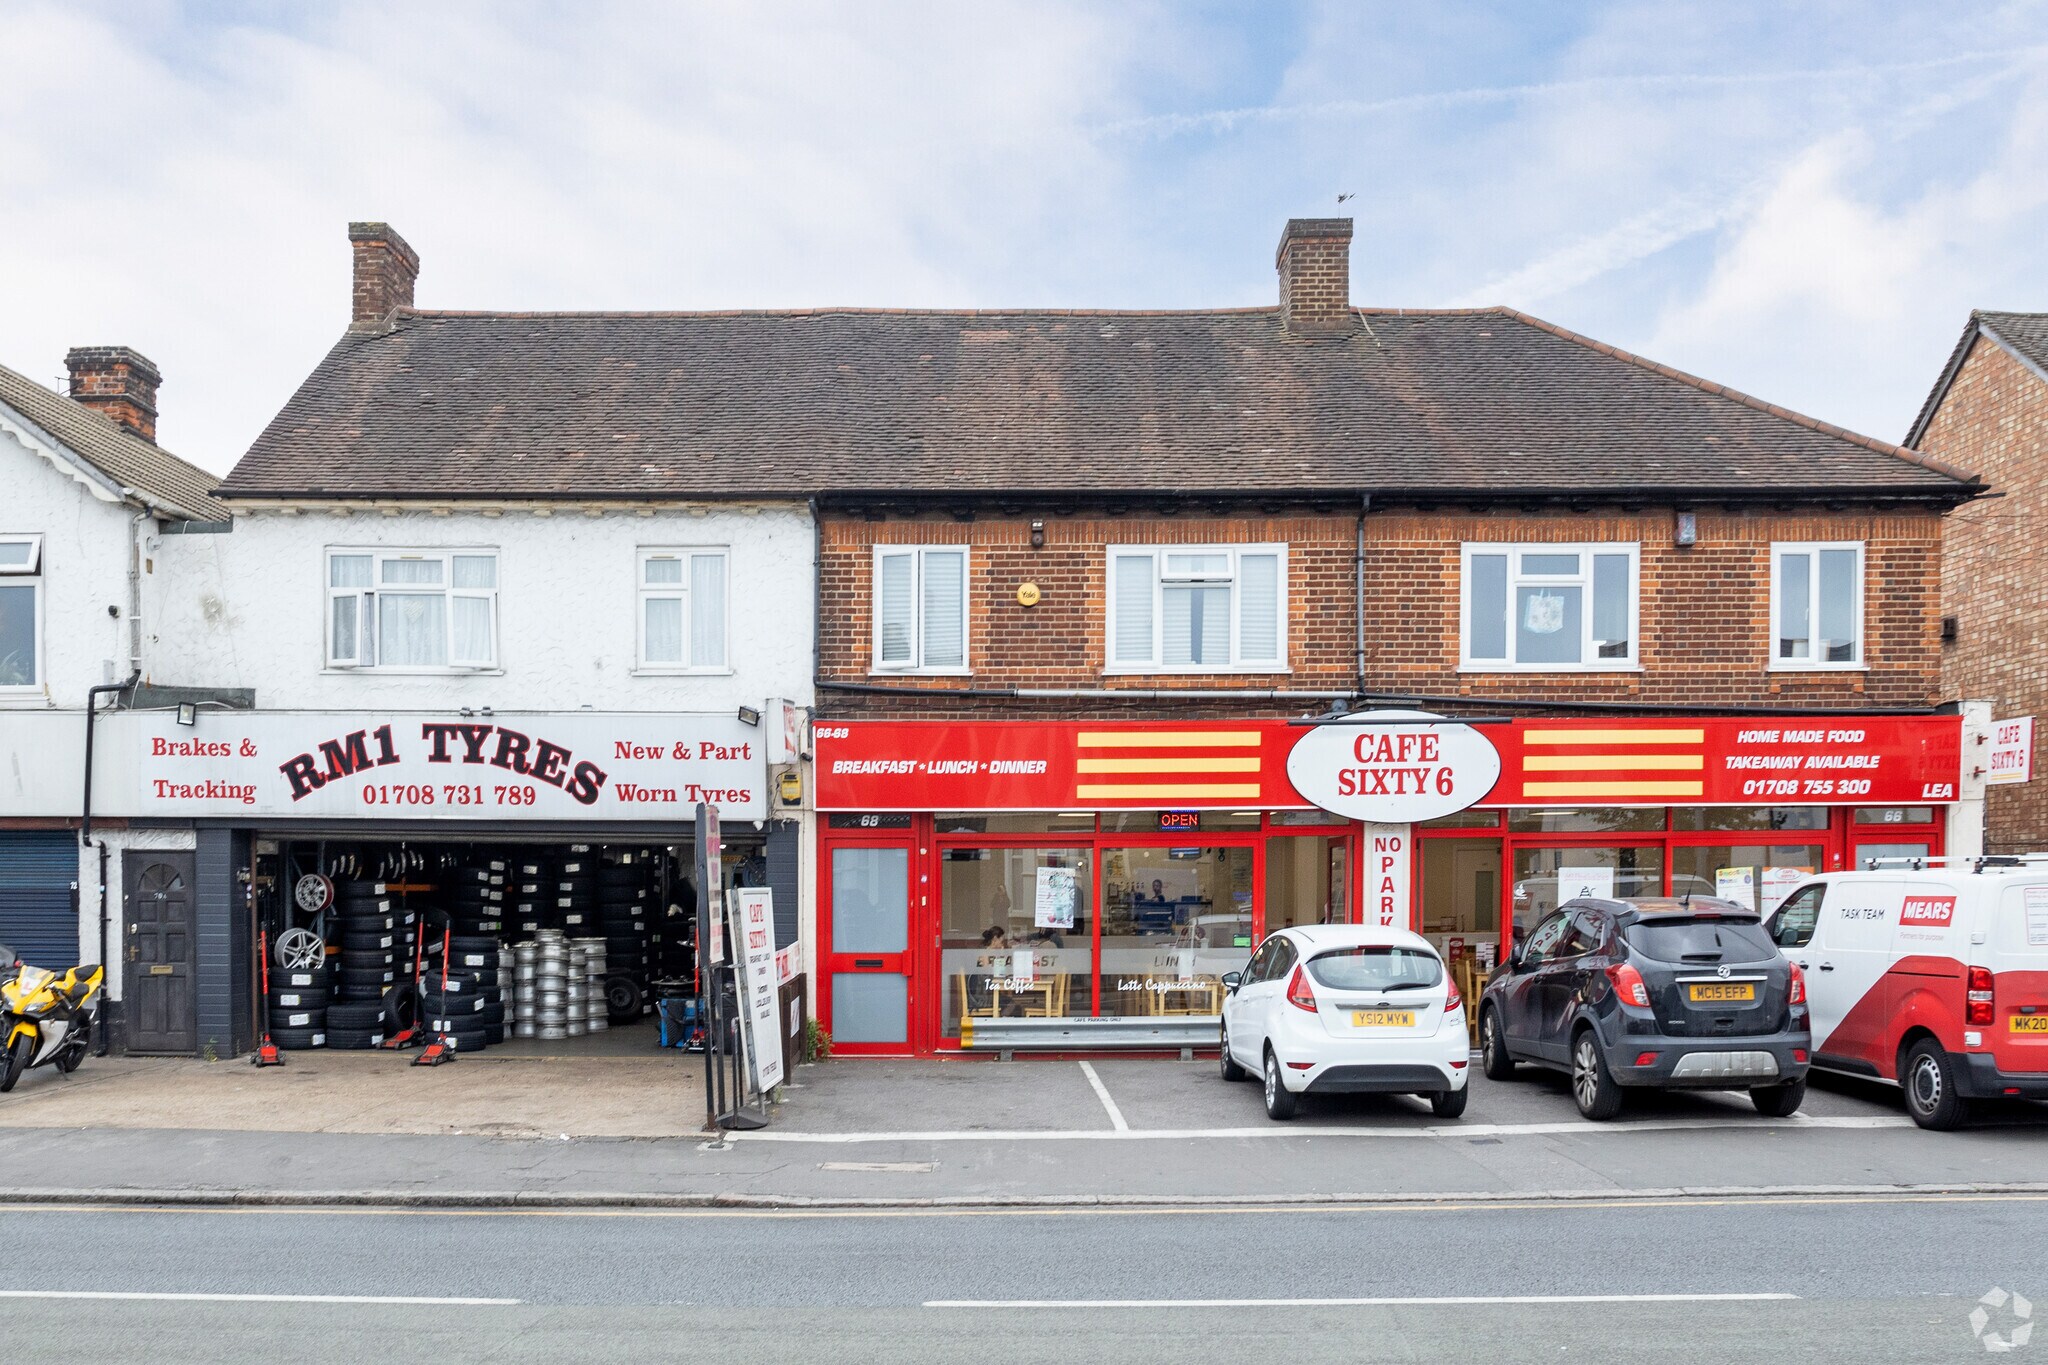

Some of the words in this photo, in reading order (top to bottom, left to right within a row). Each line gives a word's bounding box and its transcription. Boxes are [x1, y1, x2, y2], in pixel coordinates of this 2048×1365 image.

[816, 728, 849, 738] 66-68
[1737, 730, 1779, 743] HOME
[1782, 730, 1825, 743] MADE
[1827, 730, 1865, 743] FOOD
[152, 738, 231, 757] Brakes
[239, 738, 258, 758] &
[614, 741, 664, 760] New
[672, 741, 691, 760] &
[699, 742, 751, 760] Part
[279, 723, 400, 802] RM1
[422, 722, 608, 806] TYRES
[832, 760, 917, 774] BREAKFAST
[927, 760, 977, 774] LUNCH
[989, 760, 1047, 774] DINNER
[1725, 756, 1803, 769] TAKEAWAY
[1804, 756, 1880, 769] AVAILABLE
[1338, 768, 1431, 796] SIXTY
[1436, 767, 1453, 796] 6
[1743, 780, 1798, 794] 01708
[1803, 780, 1833, 794] 755
[1837, 780, 1871, 794] 300
[153, 780, 257, 804] Tracking
[363, 785, 435, 805] 01708
[443, 785, 484, 805] 731
[494, 785, 537, 806] 789
[615, 784, 677, 802] Worn
[685, 784, 751, 804] Tyres
[1922, 783, 1953, 798] LEA
[861, 815, 878, 826] 68
[1161, 814, 1198, 826] OPEN
[1884, 811, 1902, 822] 66
[1375, 837, 1402, 852] NO
[1841, 909, 1860, 919] TASK
[1863, 909, 1885, 919] TEAM
[1904, 902, 1951, 919] MEARS
[985, 979, 1000, 990] Tea
[1004, 978, 1034, 994] Coffee
[1118, 979, 1142, 991] Latte
[1145, 978, 1206, 994] Cappuccino
[1697, 987, 1722, 998] MC15
[1725, 987, 1747, 998] EFP
[1359, 1014, 1384, 1024] YS12
[1387, 1014, 1408, 1024] MYW
[2015, 1018, 2047, 1030] MK20
